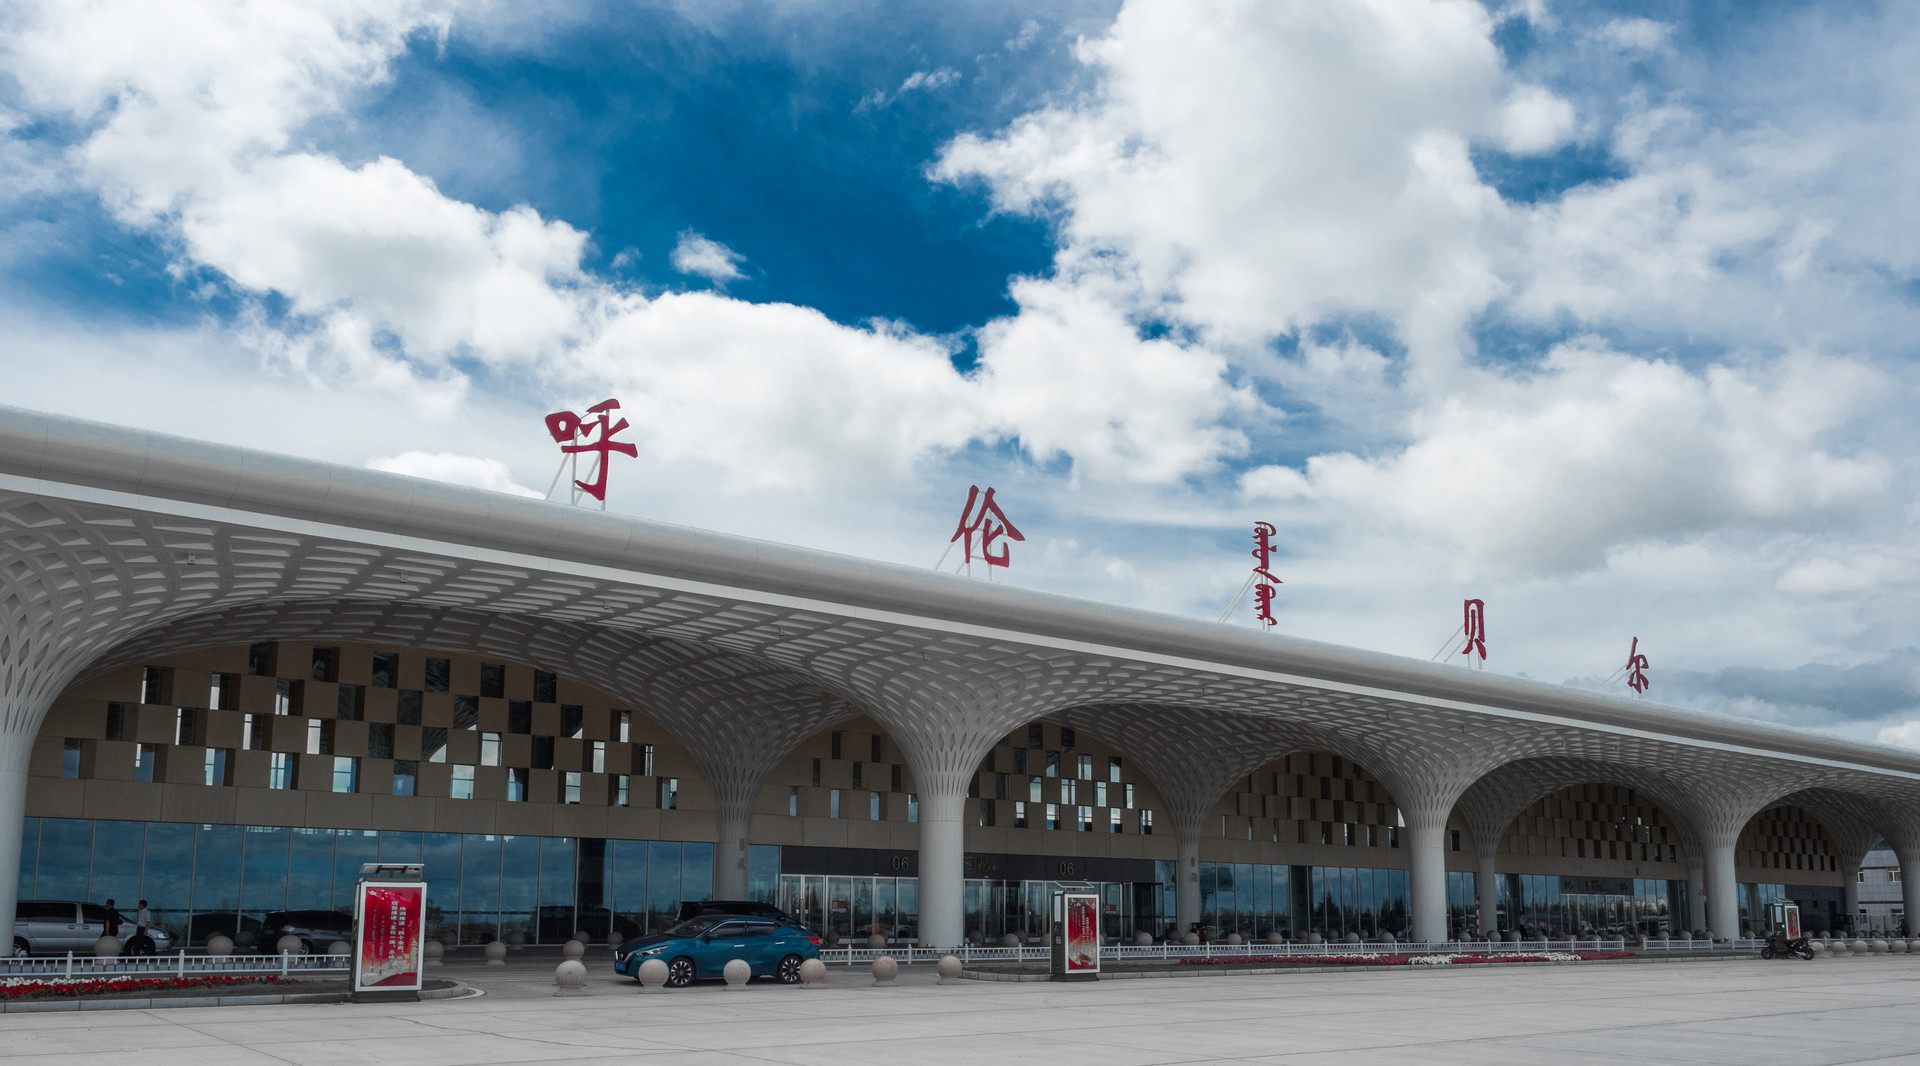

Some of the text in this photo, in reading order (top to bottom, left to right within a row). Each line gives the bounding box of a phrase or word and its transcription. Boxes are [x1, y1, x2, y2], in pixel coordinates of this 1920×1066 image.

[544, 398, 1650, 694] 呼 伦 贝 尔
[890, 856, 909, 871] 06
[1058, 862, 1075, 876] 06
